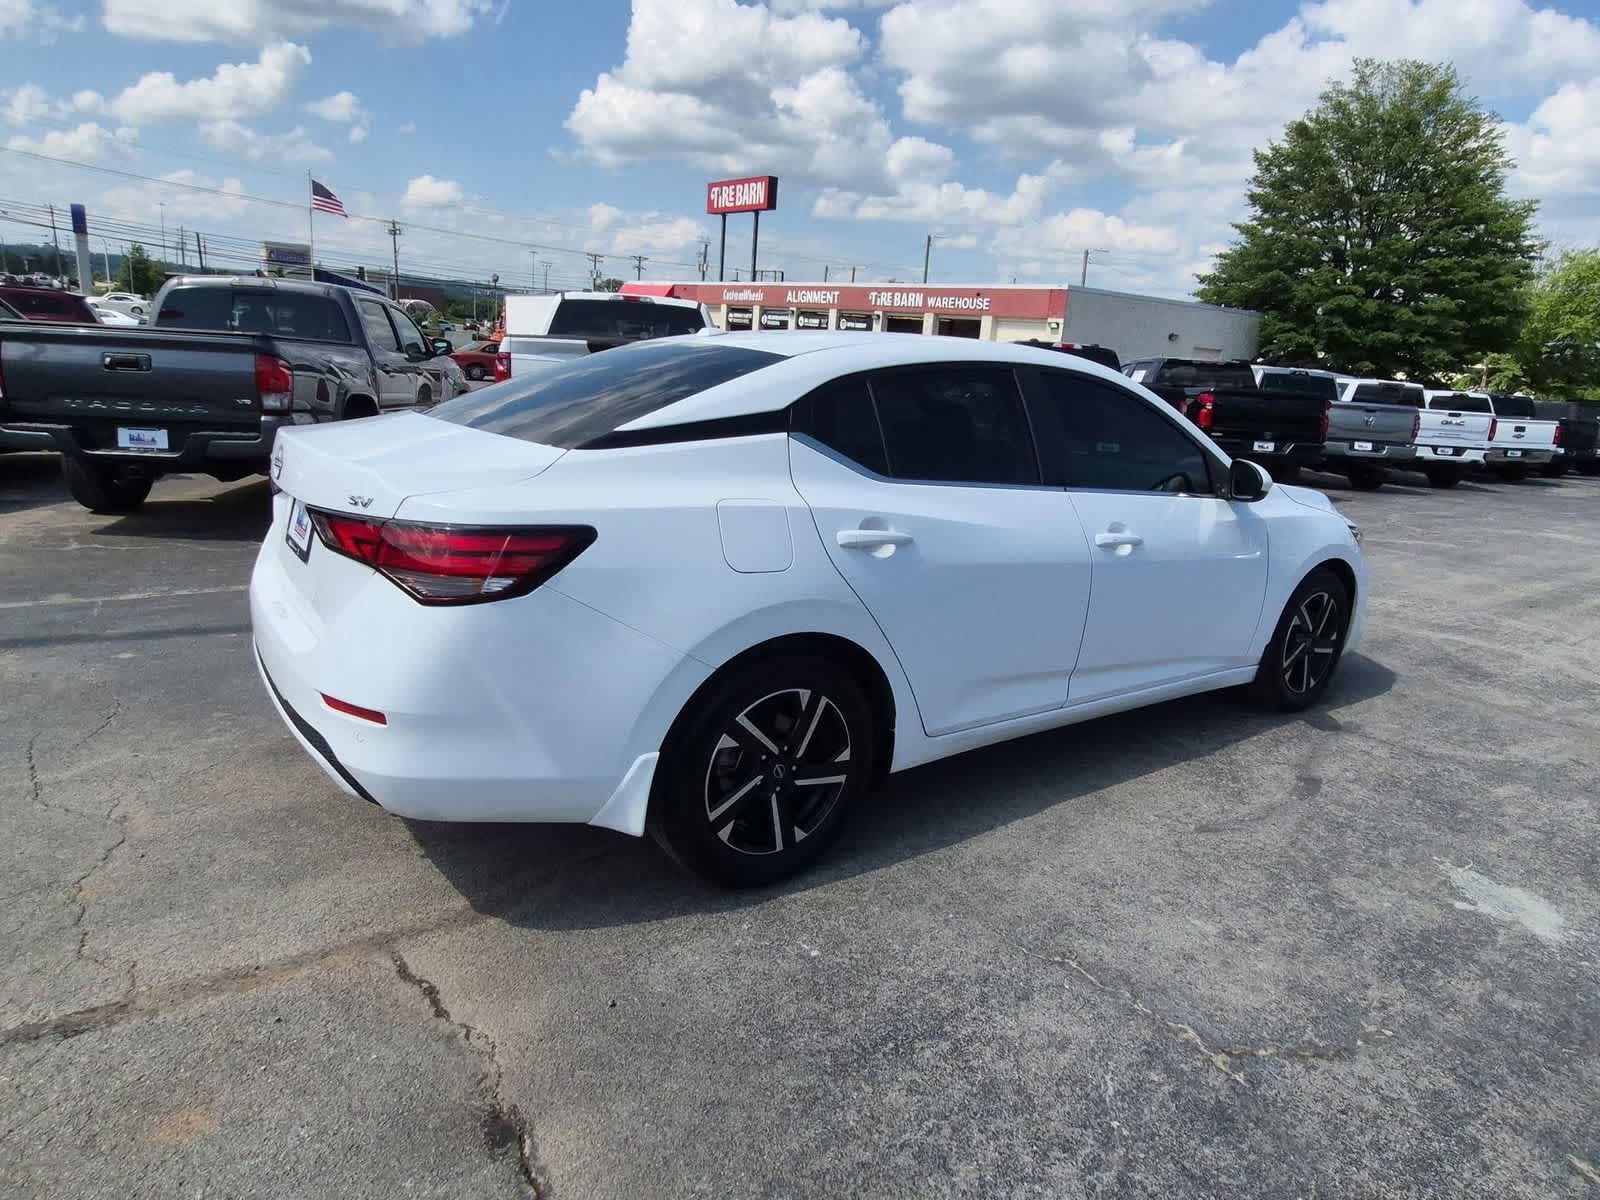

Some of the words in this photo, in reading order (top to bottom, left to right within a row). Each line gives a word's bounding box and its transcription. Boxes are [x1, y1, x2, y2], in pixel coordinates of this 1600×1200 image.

[735, 181, 766, 206] BARN
[786, 290, 840, 304] ALIGNMENT
[893, 292, 924, 308] BARN
[927, 296, 991, 310] WAREHOUSE
[63, 399, 209, 414] TACOMA
[346, 495, 375, 509] SV
